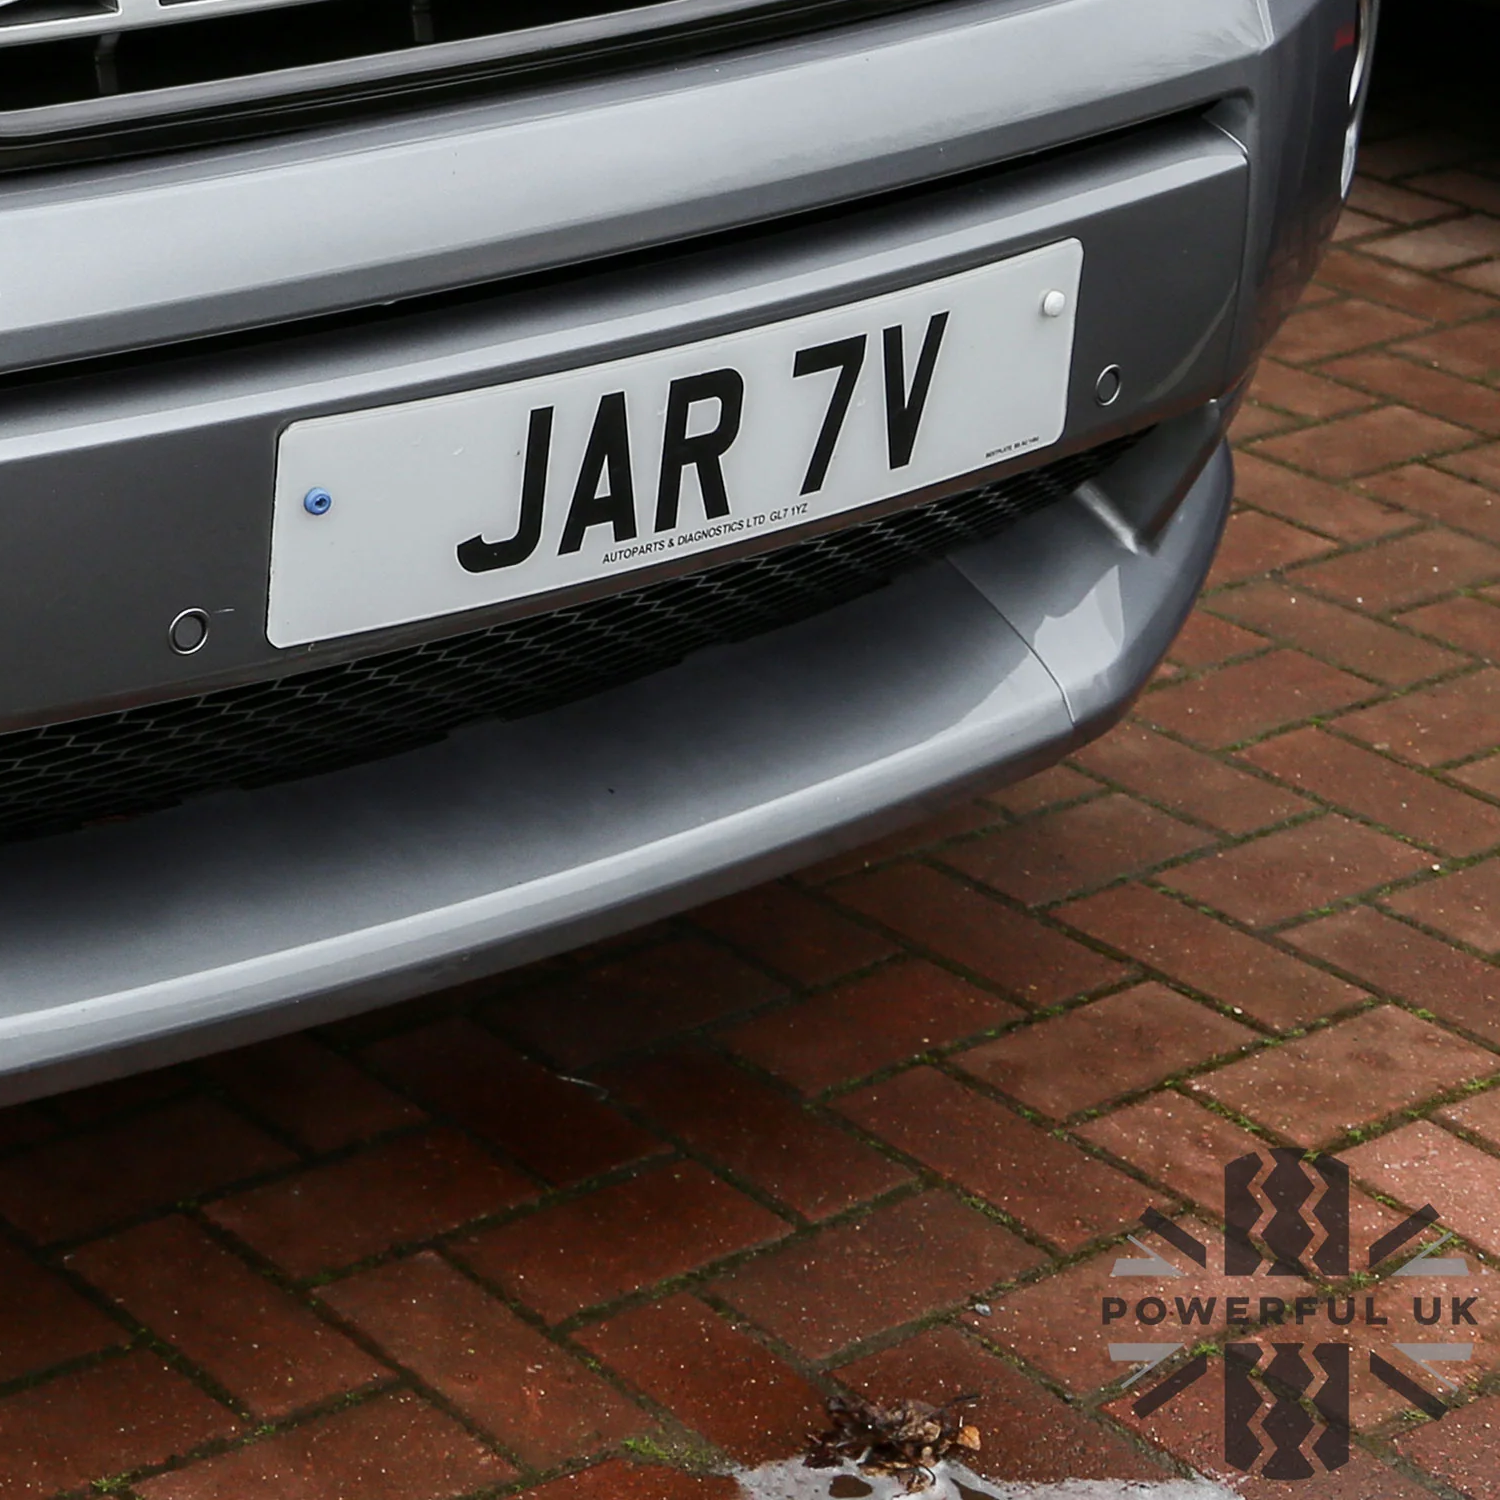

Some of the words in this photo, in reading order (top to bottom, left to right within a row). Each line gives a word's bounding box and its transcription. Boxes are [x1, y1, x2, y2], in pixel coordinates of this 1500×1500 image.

[456, 367, 744, 574] JAR
[792, 310, 951, 496] 7V
[602, 541, 665, 565] AUTOPARTS
[667, 537, 675, 549] &
[677, 519, 744, 546] DIAGNOSTICS
[746, 514, 766, 529] LTD
[769, 508, 789, 522] GL7
